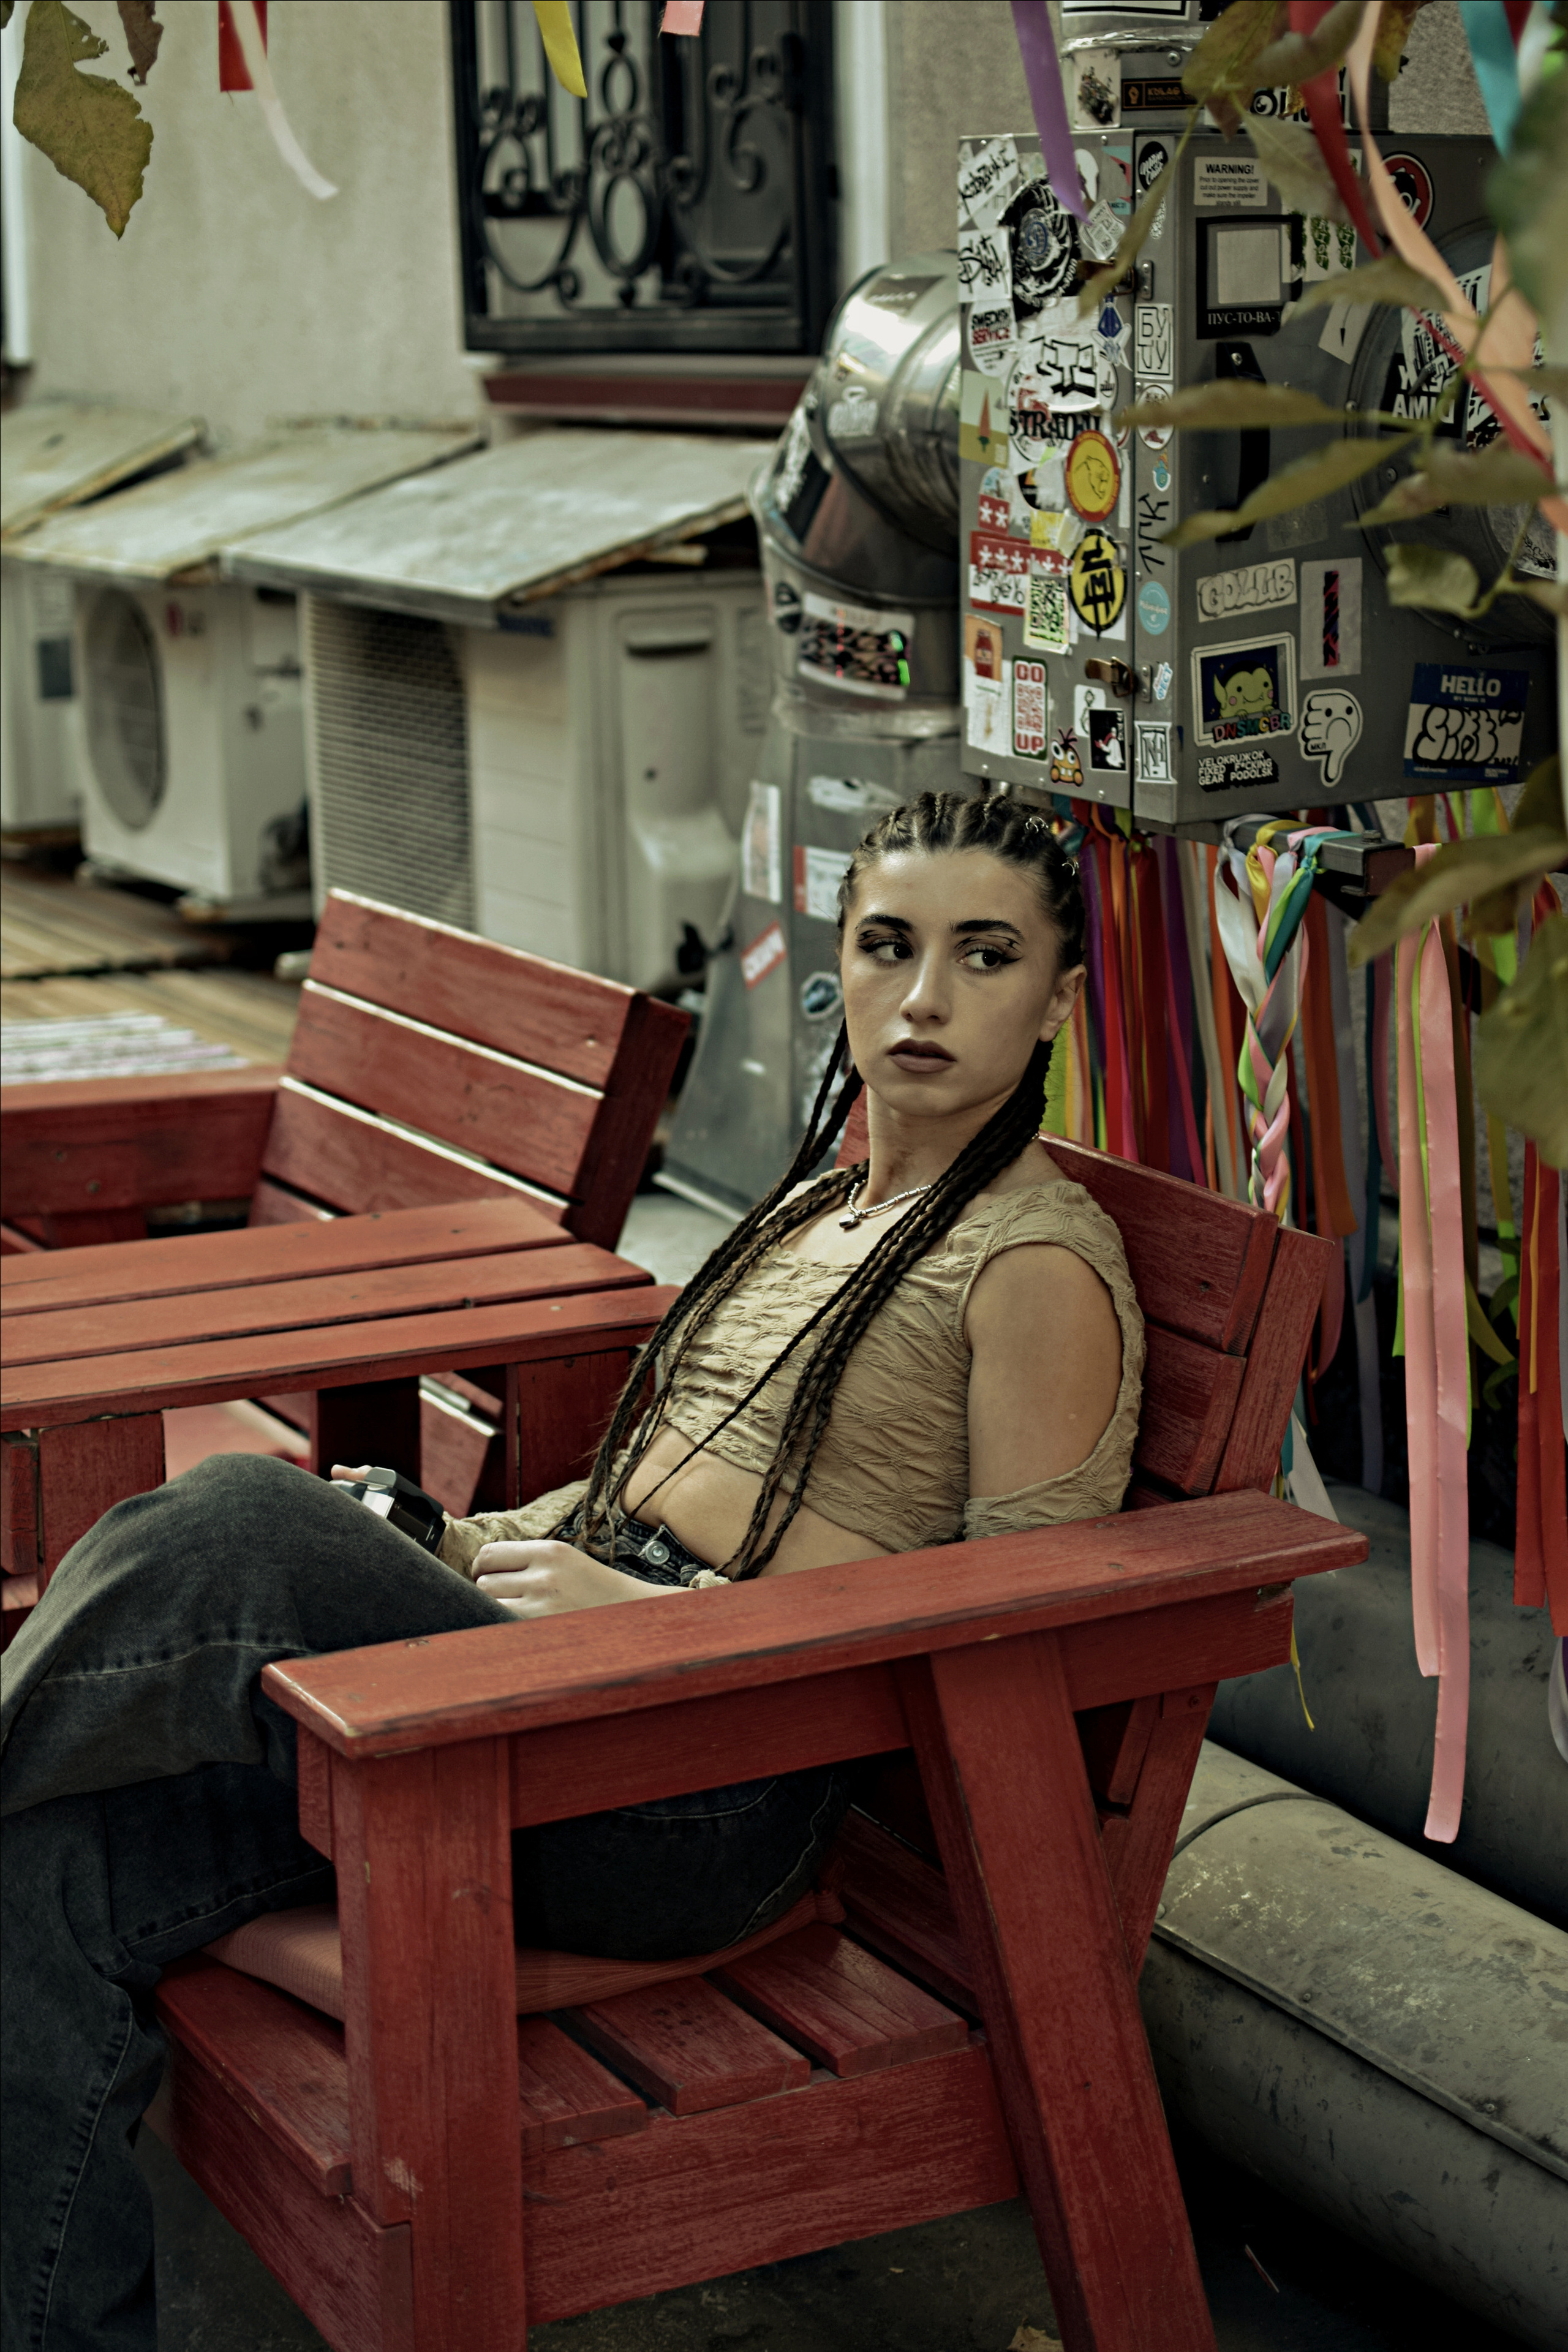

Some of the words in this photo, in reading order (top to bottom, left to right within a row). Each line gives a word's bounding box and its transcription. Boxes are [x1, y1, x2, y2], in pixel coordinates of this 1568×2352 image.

[1205, 164, 1254, 174] WARNING!
[1441, 674, 1502, 697] HELLO
[1213, 712, 1291, 742] DNSMCBR
[1016, 733, 1045, 752] UP
[1198, 765, 1226, 777] FIXED
[1198, 774, 1225, 786] GEAR
[1230, 768, 1273, 782] PODOLSK
